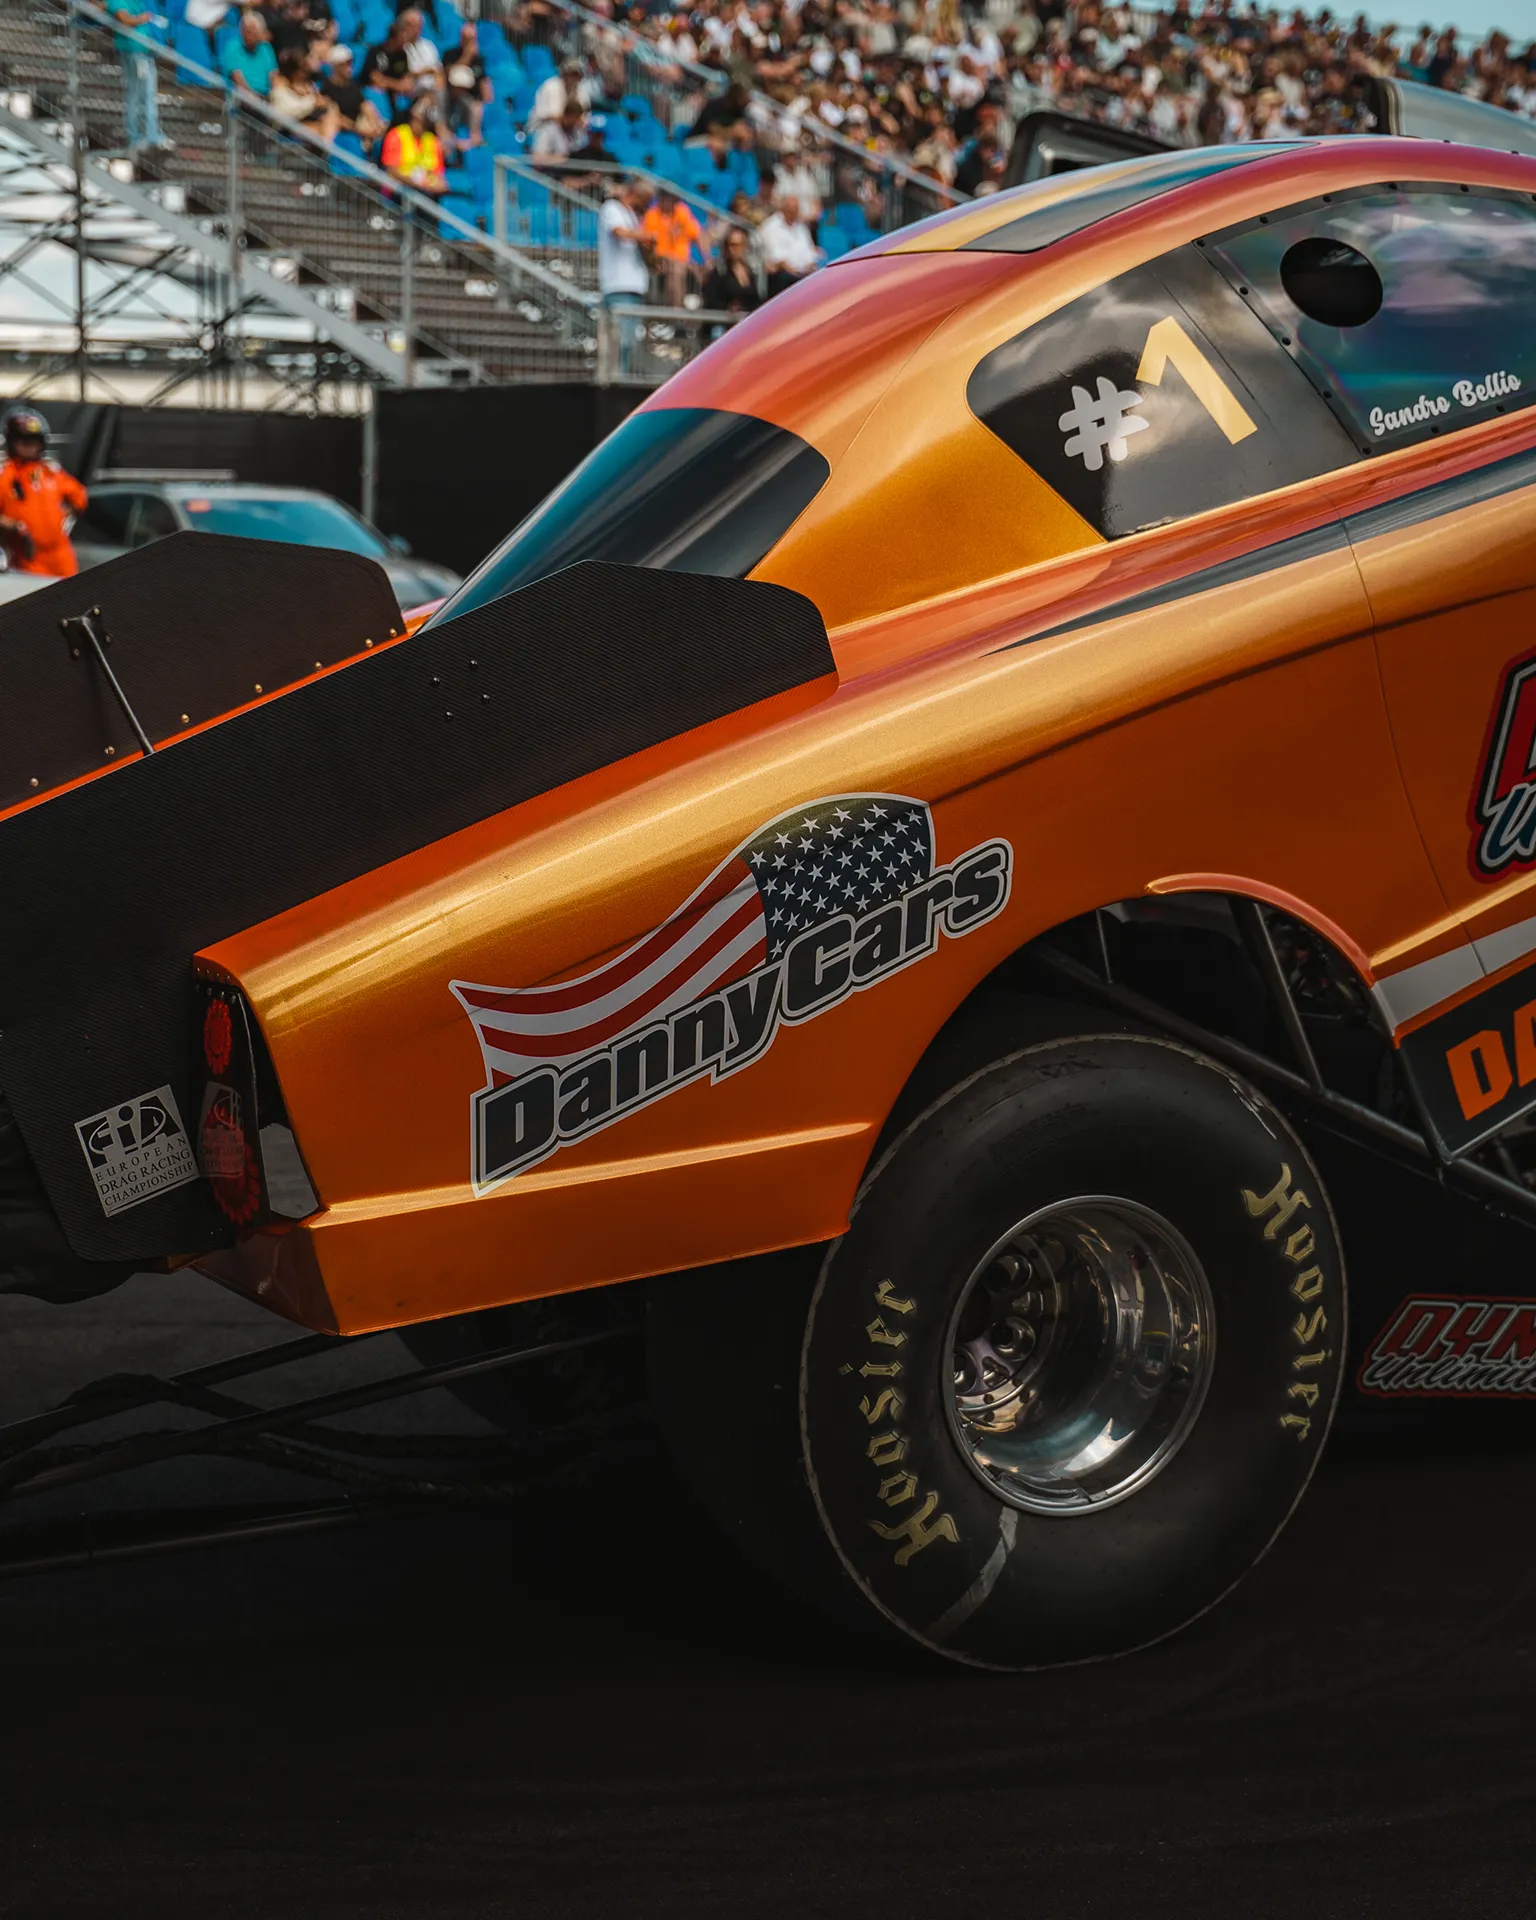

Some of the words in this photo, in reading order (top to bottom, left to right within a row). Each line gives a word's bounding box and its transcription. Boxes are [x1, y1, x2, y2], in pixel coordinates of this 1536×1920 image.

[1058, 315, 1258, 471] #1
[1369, 394, 1450, 436] Sandro
[1452, 370, 1521, 407] Bellio
[94, 1136, 187, 1182] EUROPEAN
[99, 1171, 138, 1195] DRAG
[140, 1148, 191, 1178] RACING
[104, 1161, 194, 1206] CHAMPIONSHIP
[1242, 1162, 1334, 1441] Hoosier
[838, 1277, 960, 1567] Hoosier
